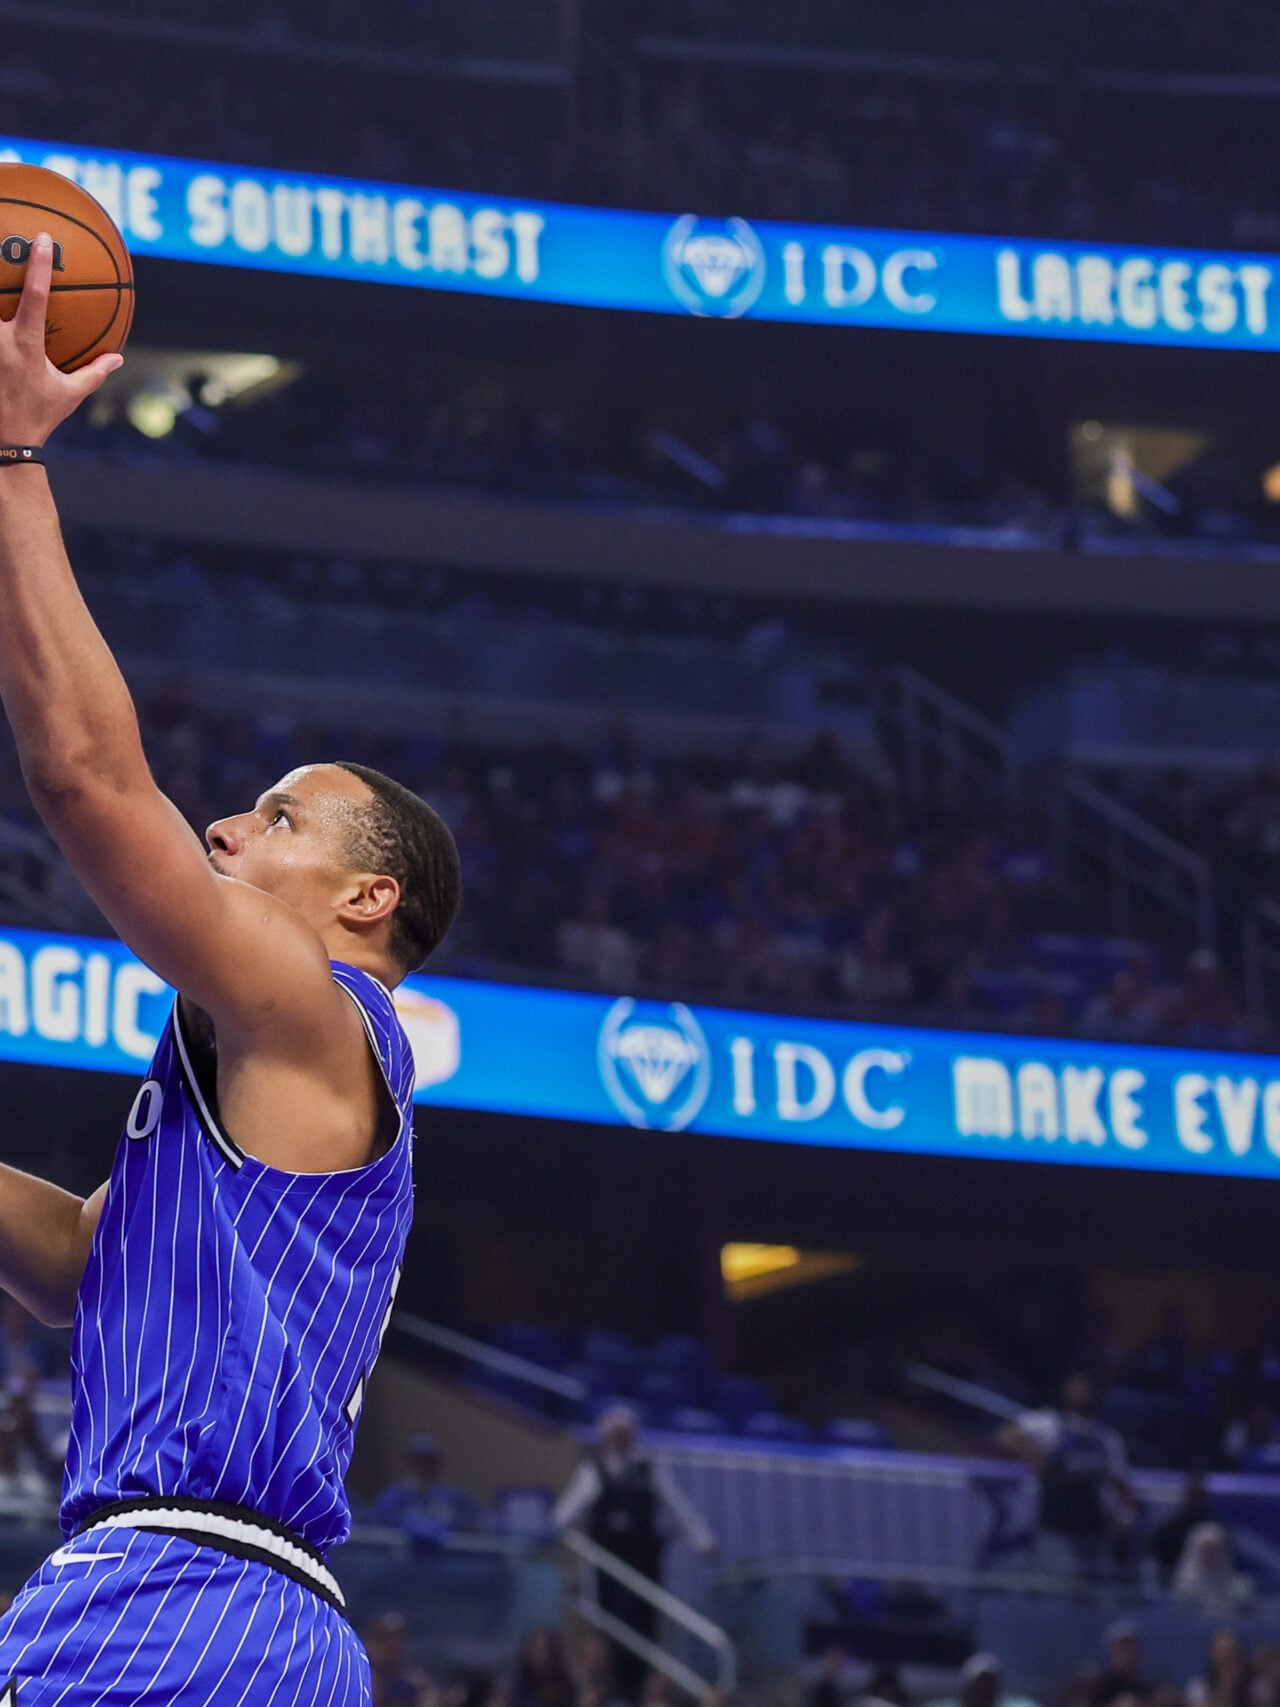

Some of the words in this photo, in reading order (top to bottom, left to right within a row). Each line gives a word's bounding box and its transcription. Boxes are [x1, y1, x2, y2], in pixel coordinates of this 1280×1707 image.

[186, 174, 545, 284] SOUTHEAST
[782, 241, 938, 315] IDC
[997, 249, 1272, 336] LARGEST
[731, 1036, 912, 1130] IDC
[953, 1055, 1148, 1149] MAKE
